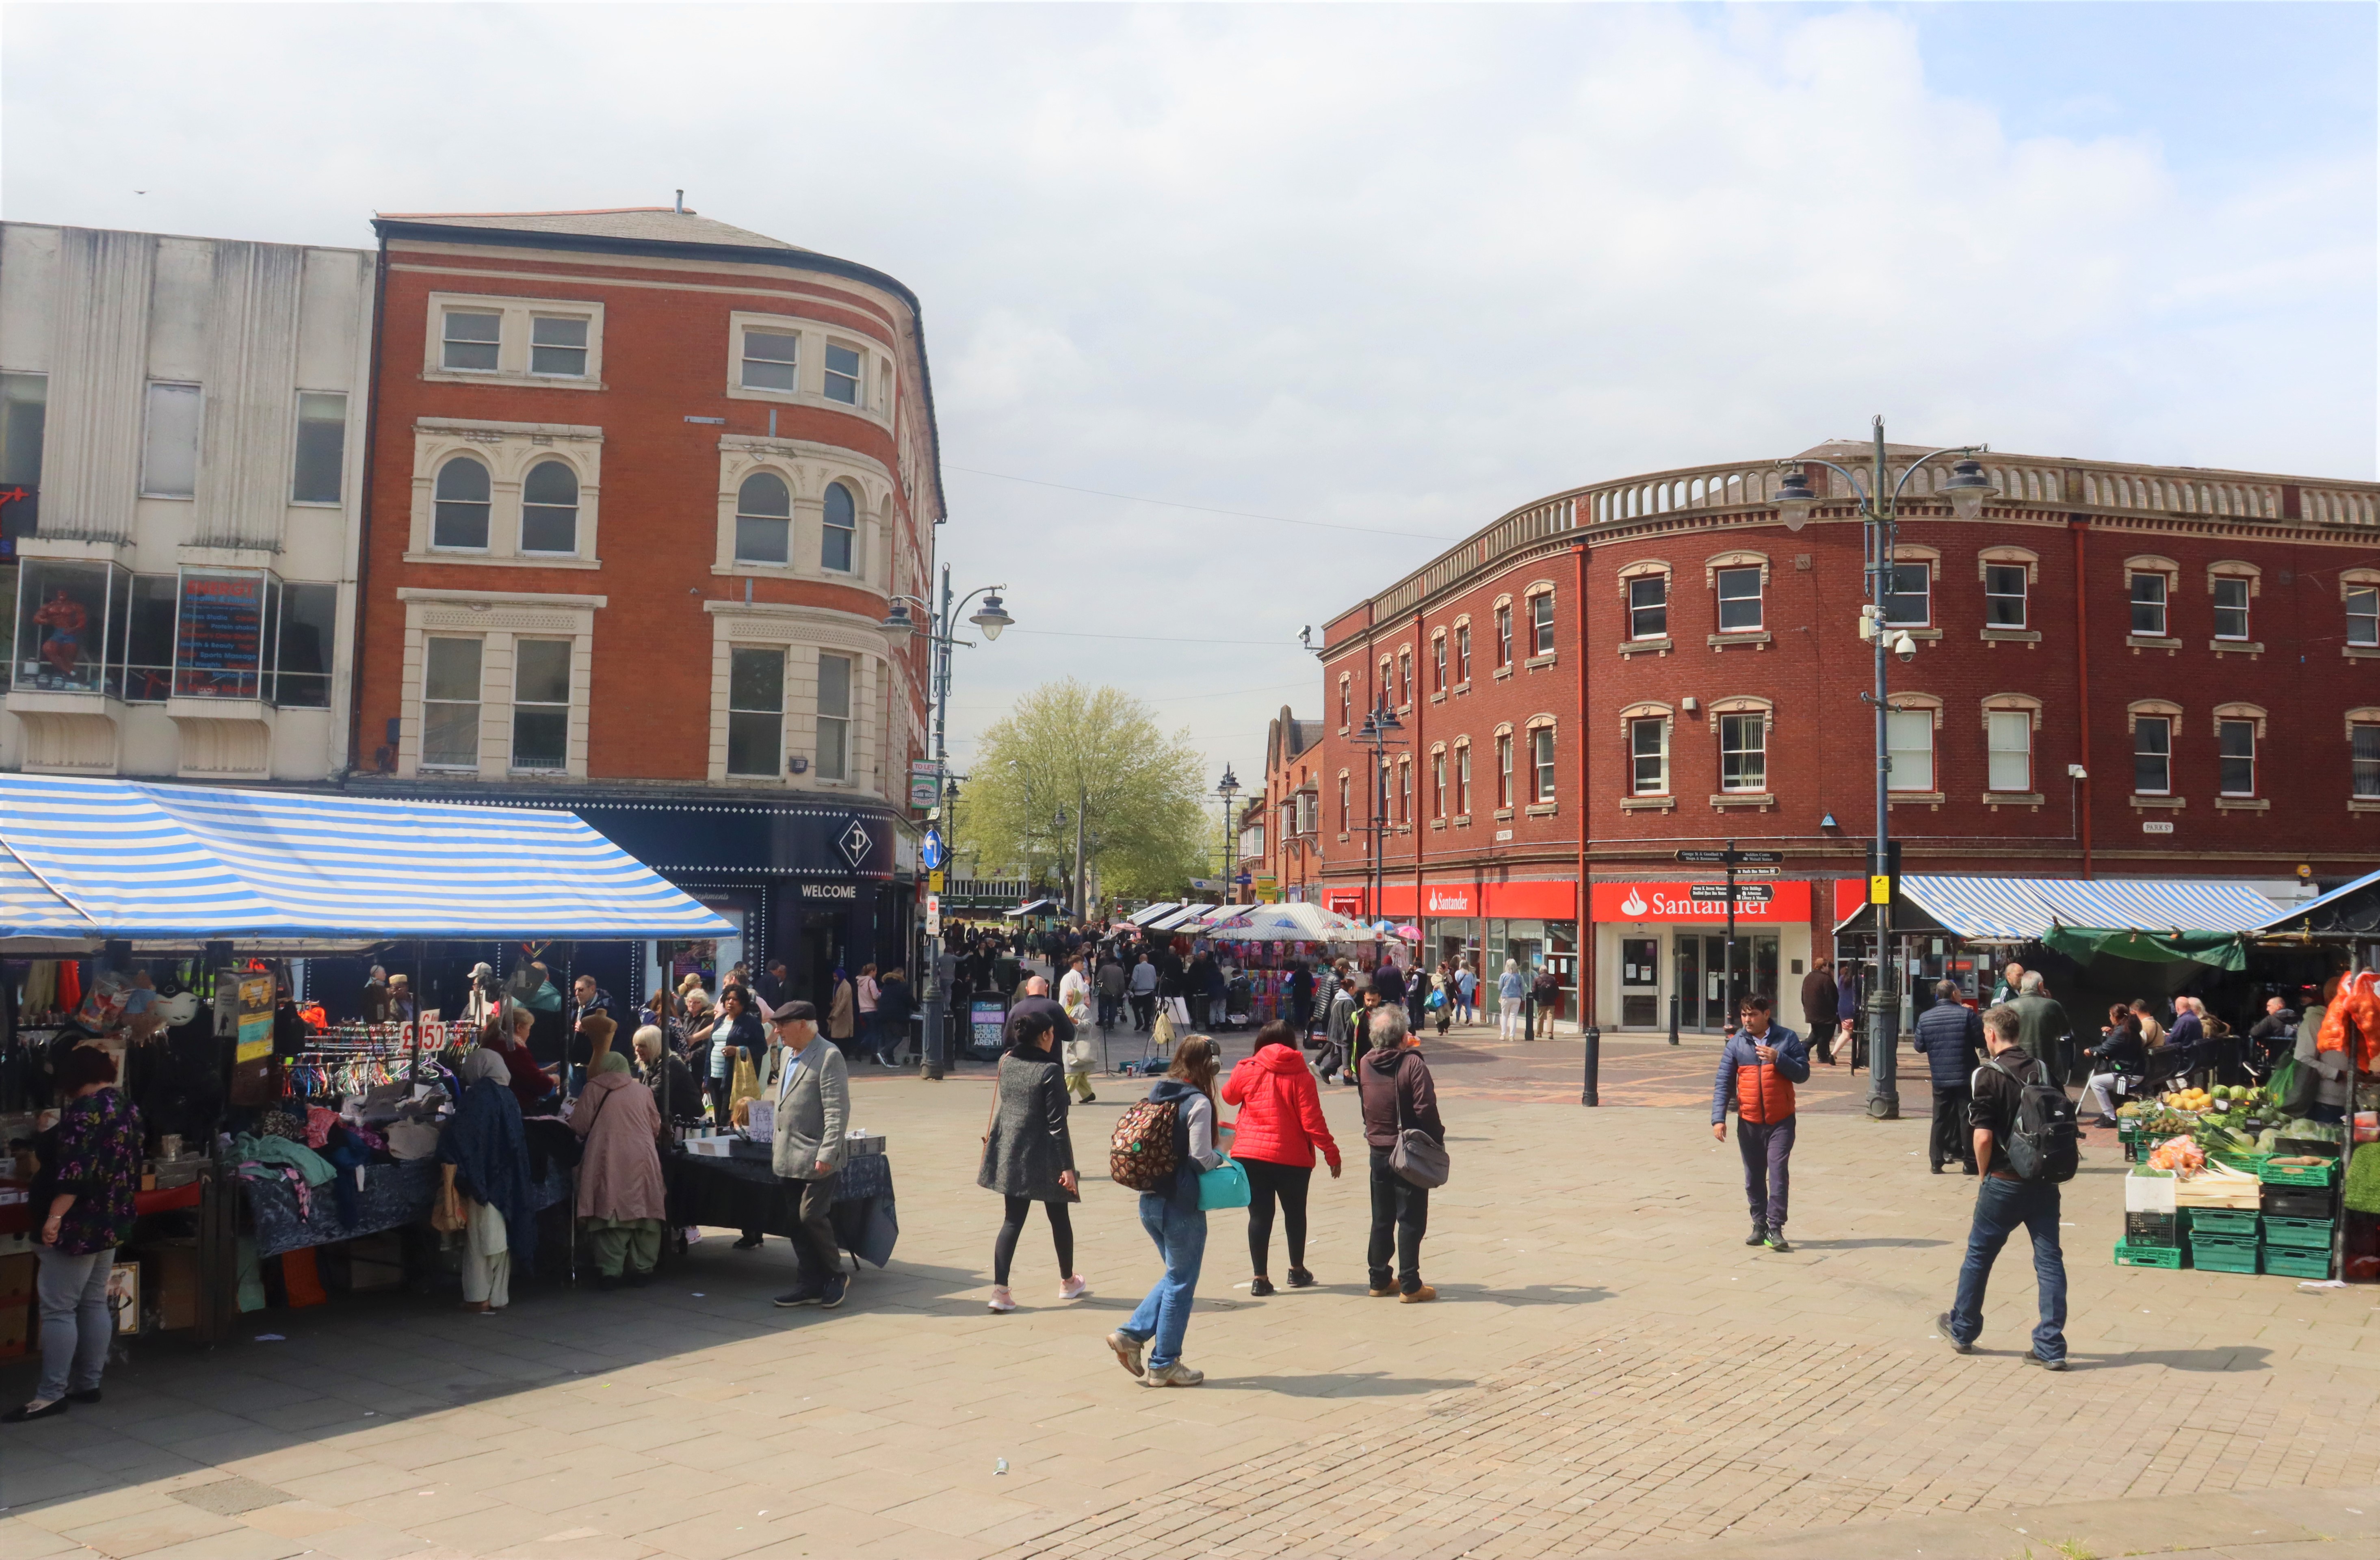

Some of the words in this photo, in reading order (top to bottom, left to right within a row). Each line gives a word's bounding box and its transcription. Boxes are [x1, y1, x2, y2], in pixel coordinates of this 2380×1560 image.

[224, 653, 257, 661] Massage
[801, 885, 856, 898] WELCOME
[1438, 890, 1468, 910] Santander
